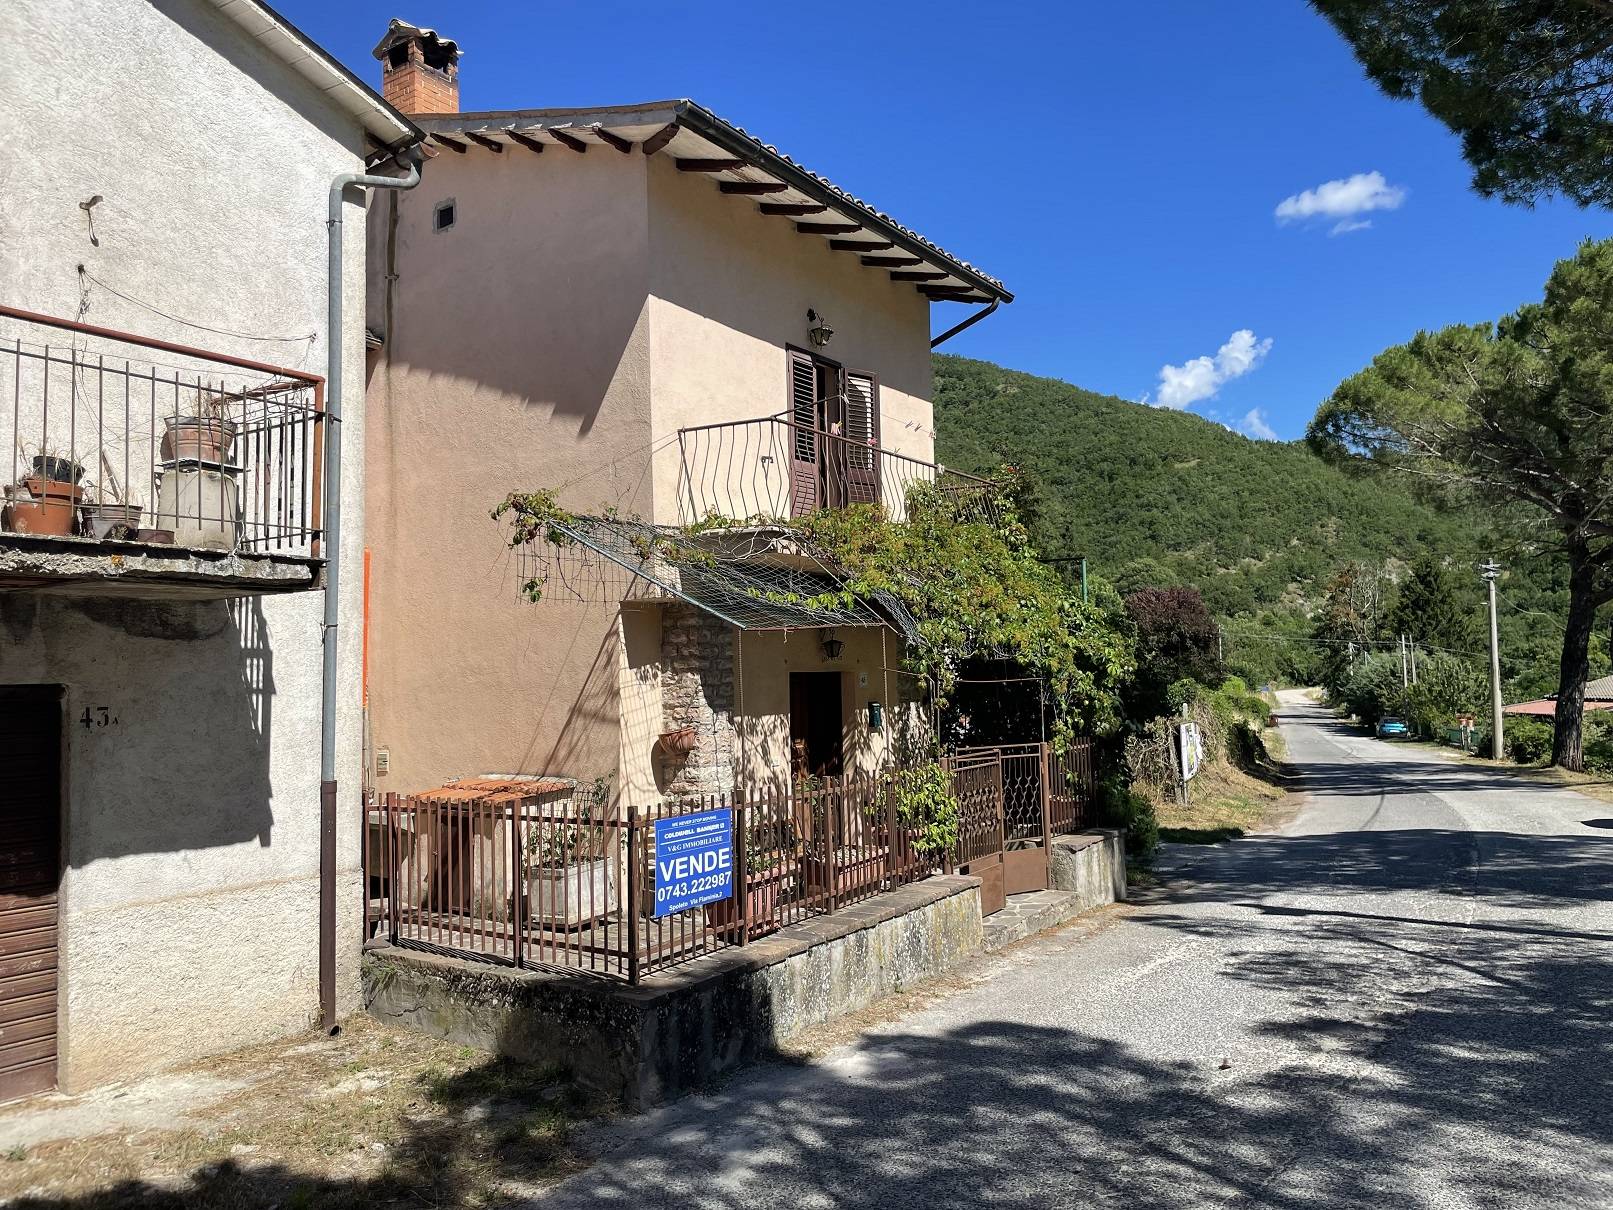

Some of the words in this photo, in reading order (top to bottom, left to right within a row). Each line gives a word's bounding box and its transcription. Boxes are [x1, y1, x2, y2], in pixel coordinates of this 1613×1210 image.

[665, 829, 695, 839] COLDWELL
[668, 843, 682, 852] V&G
[683, 836, 723, 850] IMMOBILIARE
[660, 848, 731, 882] VENDE
[658, 871, 732, 902] 0743.222987
[669, 902, 689, 912] Spoleto
